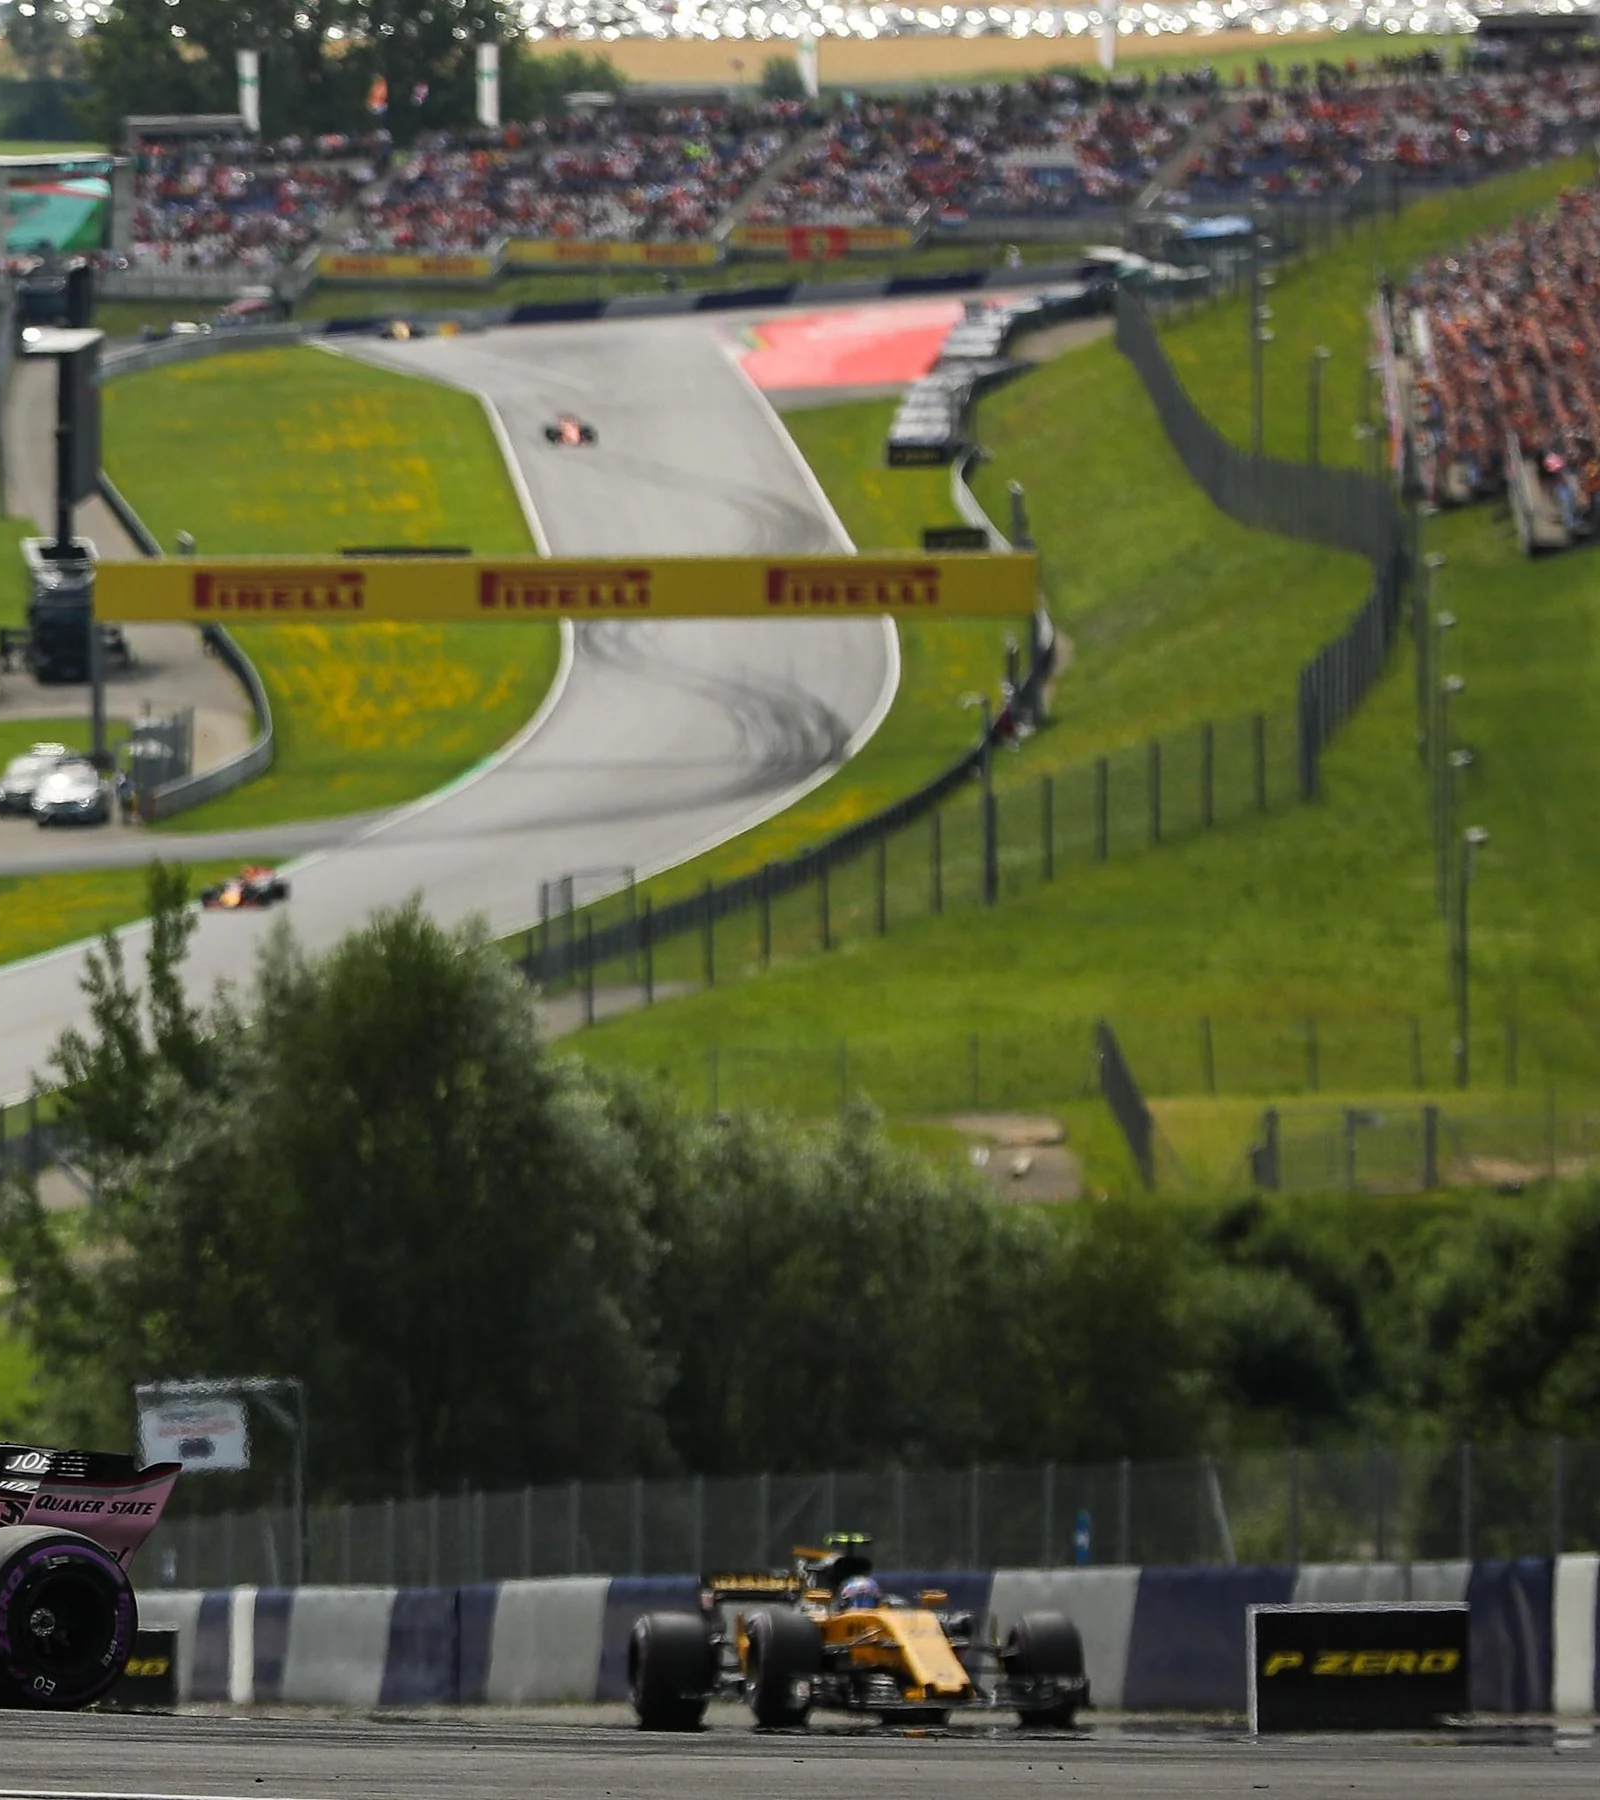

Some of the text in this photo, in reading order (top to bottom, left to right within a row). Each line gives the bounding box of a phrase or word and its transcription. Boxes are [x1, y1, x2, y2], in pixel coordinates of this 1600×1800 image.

[193, 571, 364, 610] PIRELLI
[478, 568, 652, 609] PIRELLI
[765, 566, 941, 606] PIRELLI
[35, 1495, 105, 1514] QUAKER
[107, 1501, 157, 1516] STATE
[1264, 1650, 1460, 1676] P ZERO
